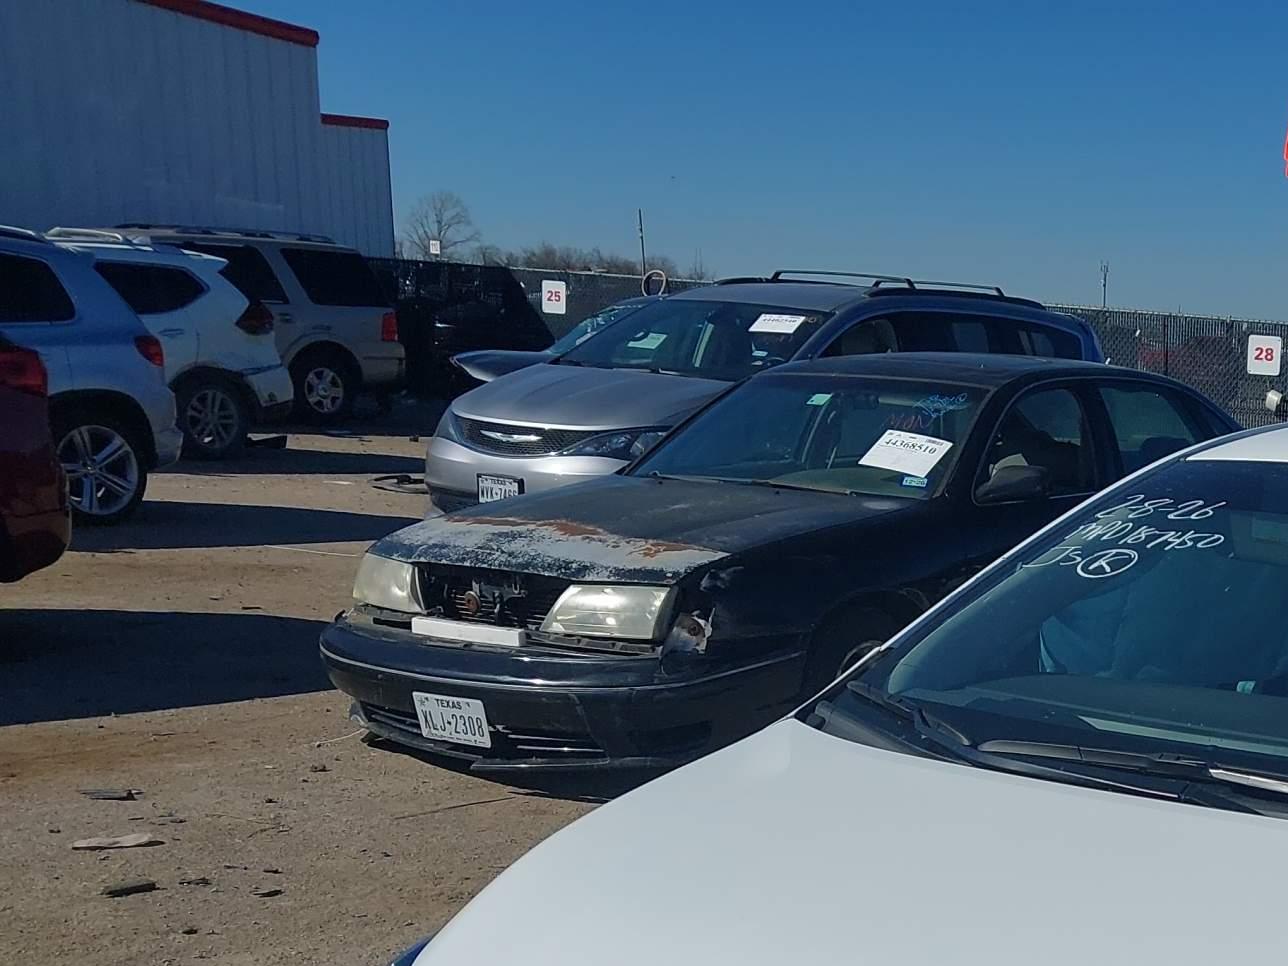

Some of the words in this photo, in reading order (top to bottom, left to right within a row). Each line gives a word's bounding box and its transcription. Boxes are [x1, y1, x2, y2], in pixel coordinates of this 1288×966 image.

[546, 289, 561, 303] 25
[1253, 346, 1275, 362] 28
[884, 438, 937, 455] 44368510
[434, 698, 462, 710] TEXAS
